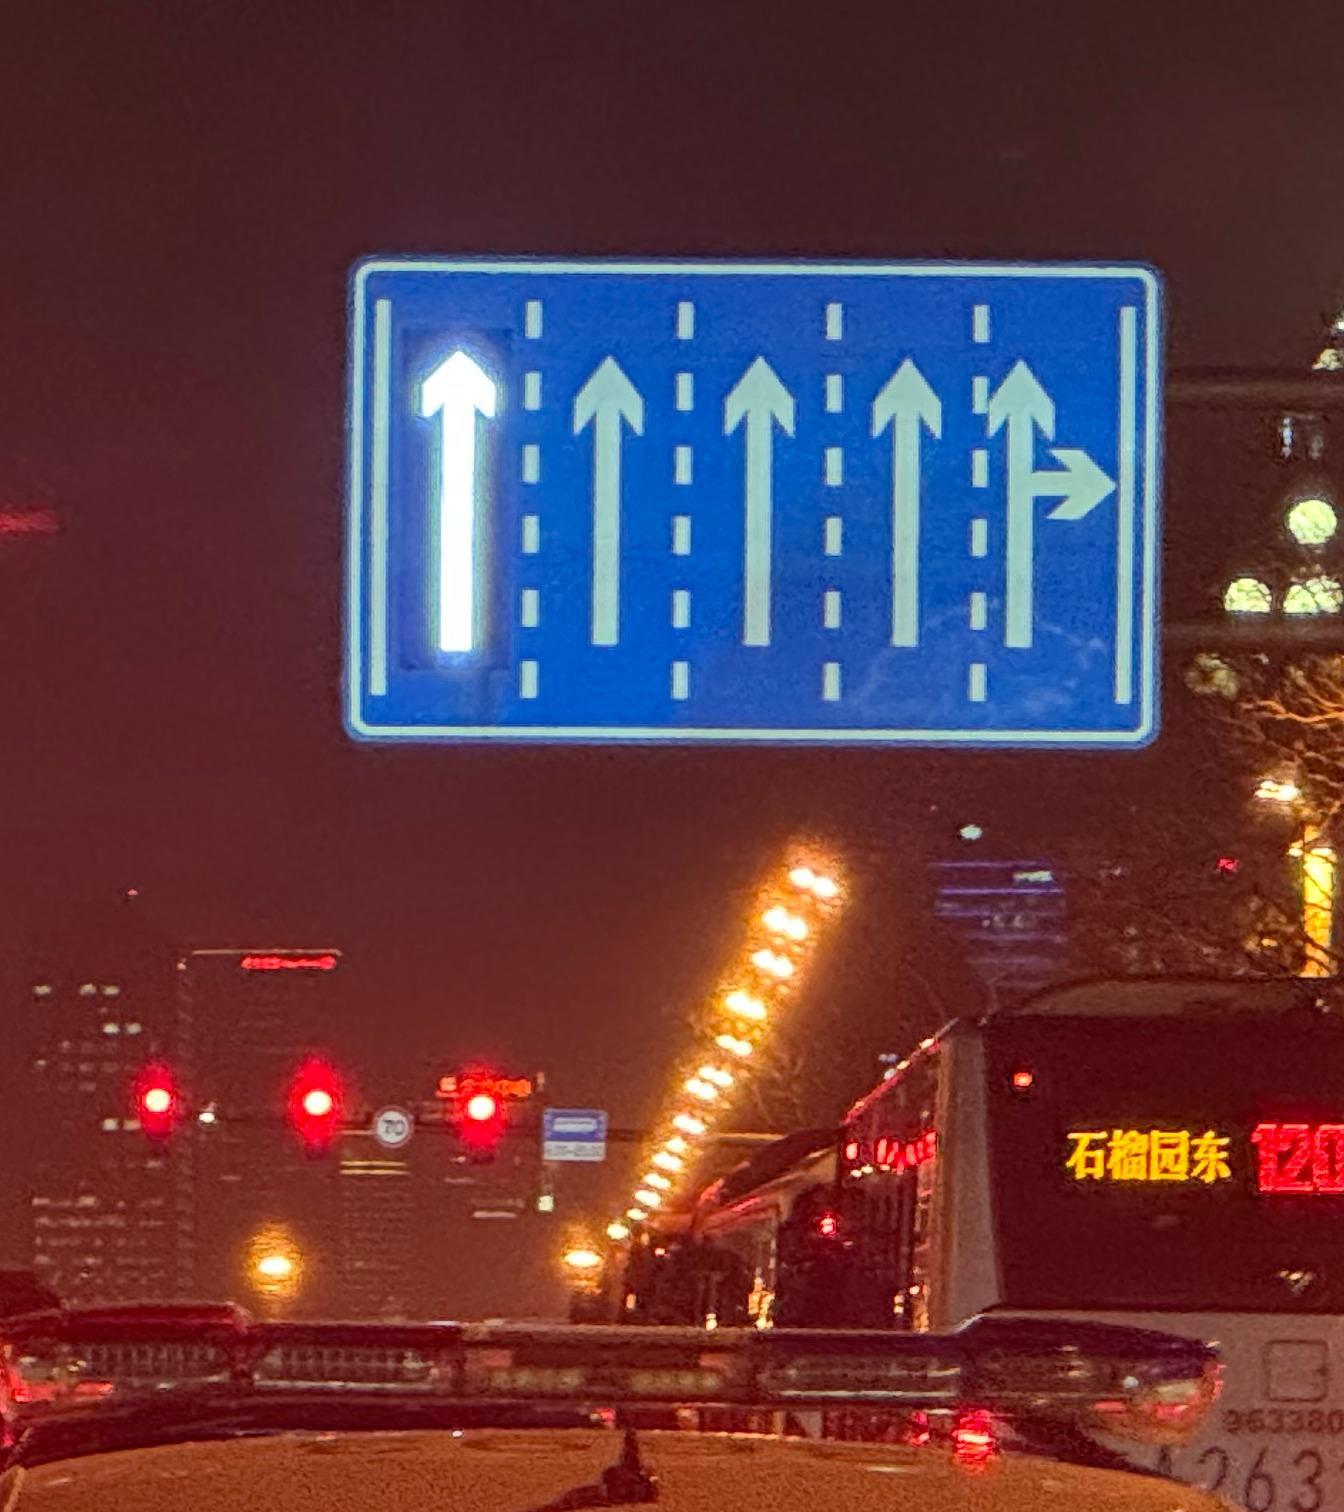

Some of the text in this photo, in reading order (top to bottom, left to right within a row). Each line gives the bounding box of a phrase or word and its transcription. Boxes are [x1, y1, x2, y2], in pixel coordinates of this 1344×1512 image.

[382, 1117, 406, 1137] 70
[1065, 1129, 1233, 1183] 石榴园东
